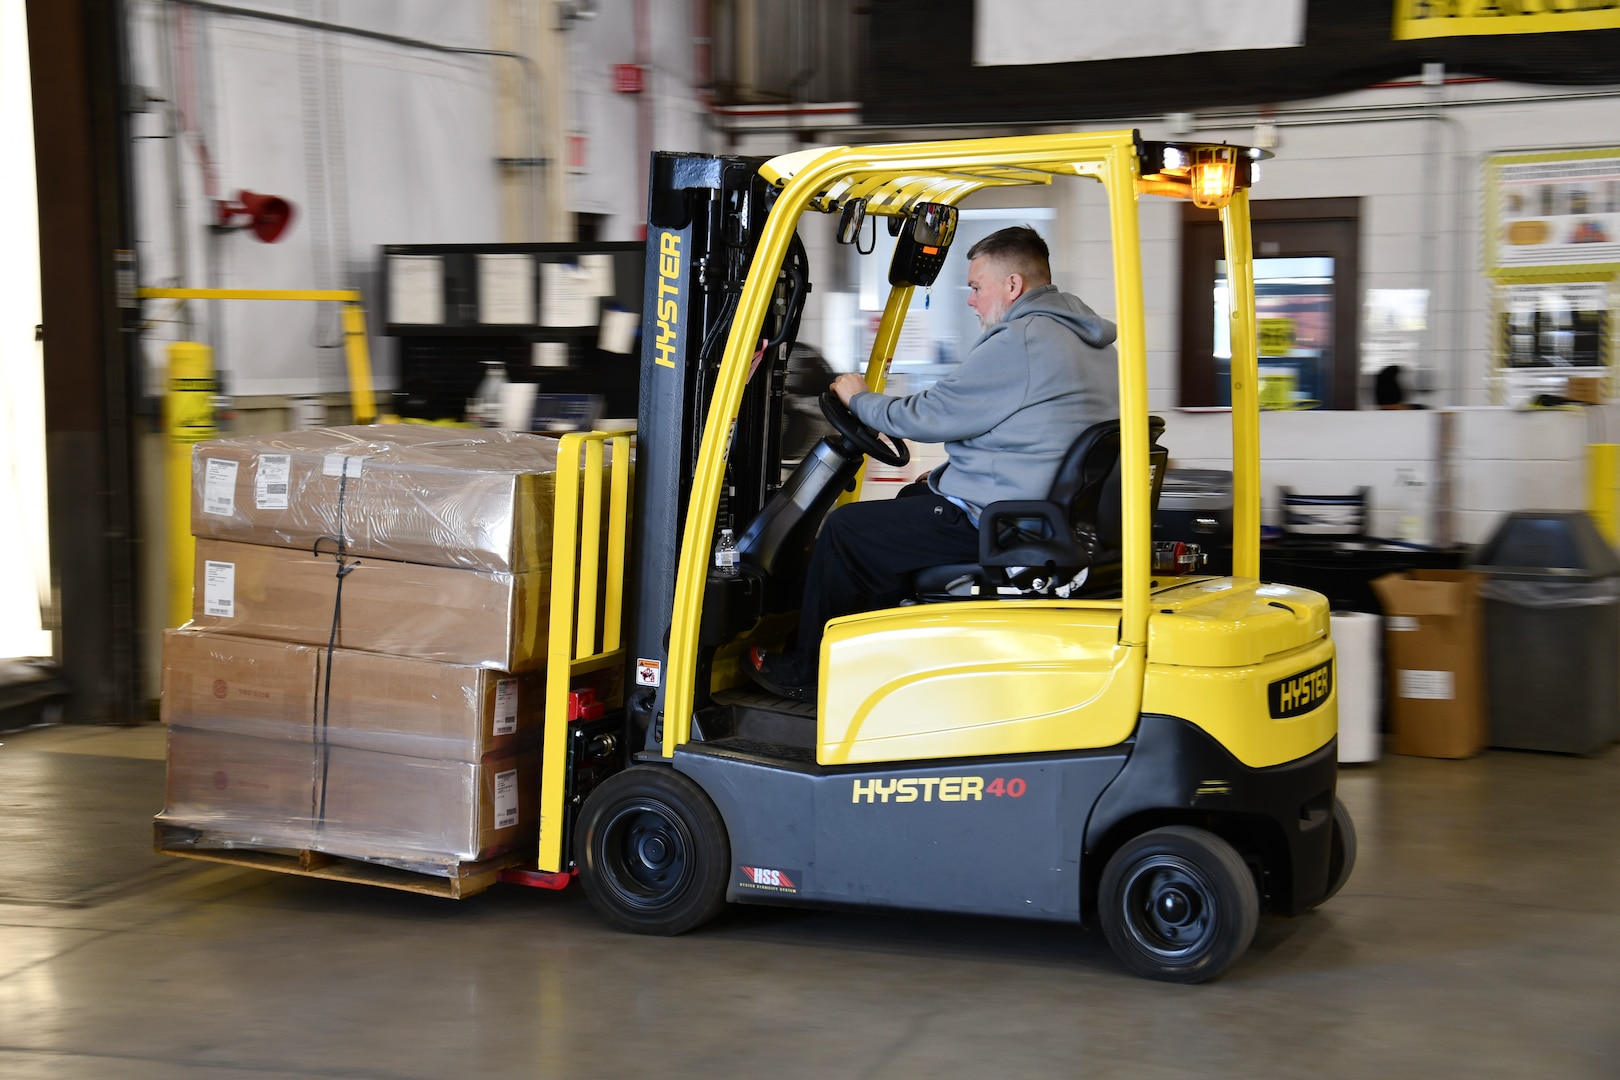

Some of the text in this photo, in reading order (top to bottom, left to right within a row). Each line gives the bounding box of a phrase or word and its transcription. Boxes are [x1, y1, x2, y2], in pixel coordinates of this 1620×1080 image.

[655, 231, 681, 369] HYSTER
[1280, 666, 1328, 713] HYSTER
[852, 776, 1027, 803] HYSTER 40
[753, 867, 780, 886] HSS
